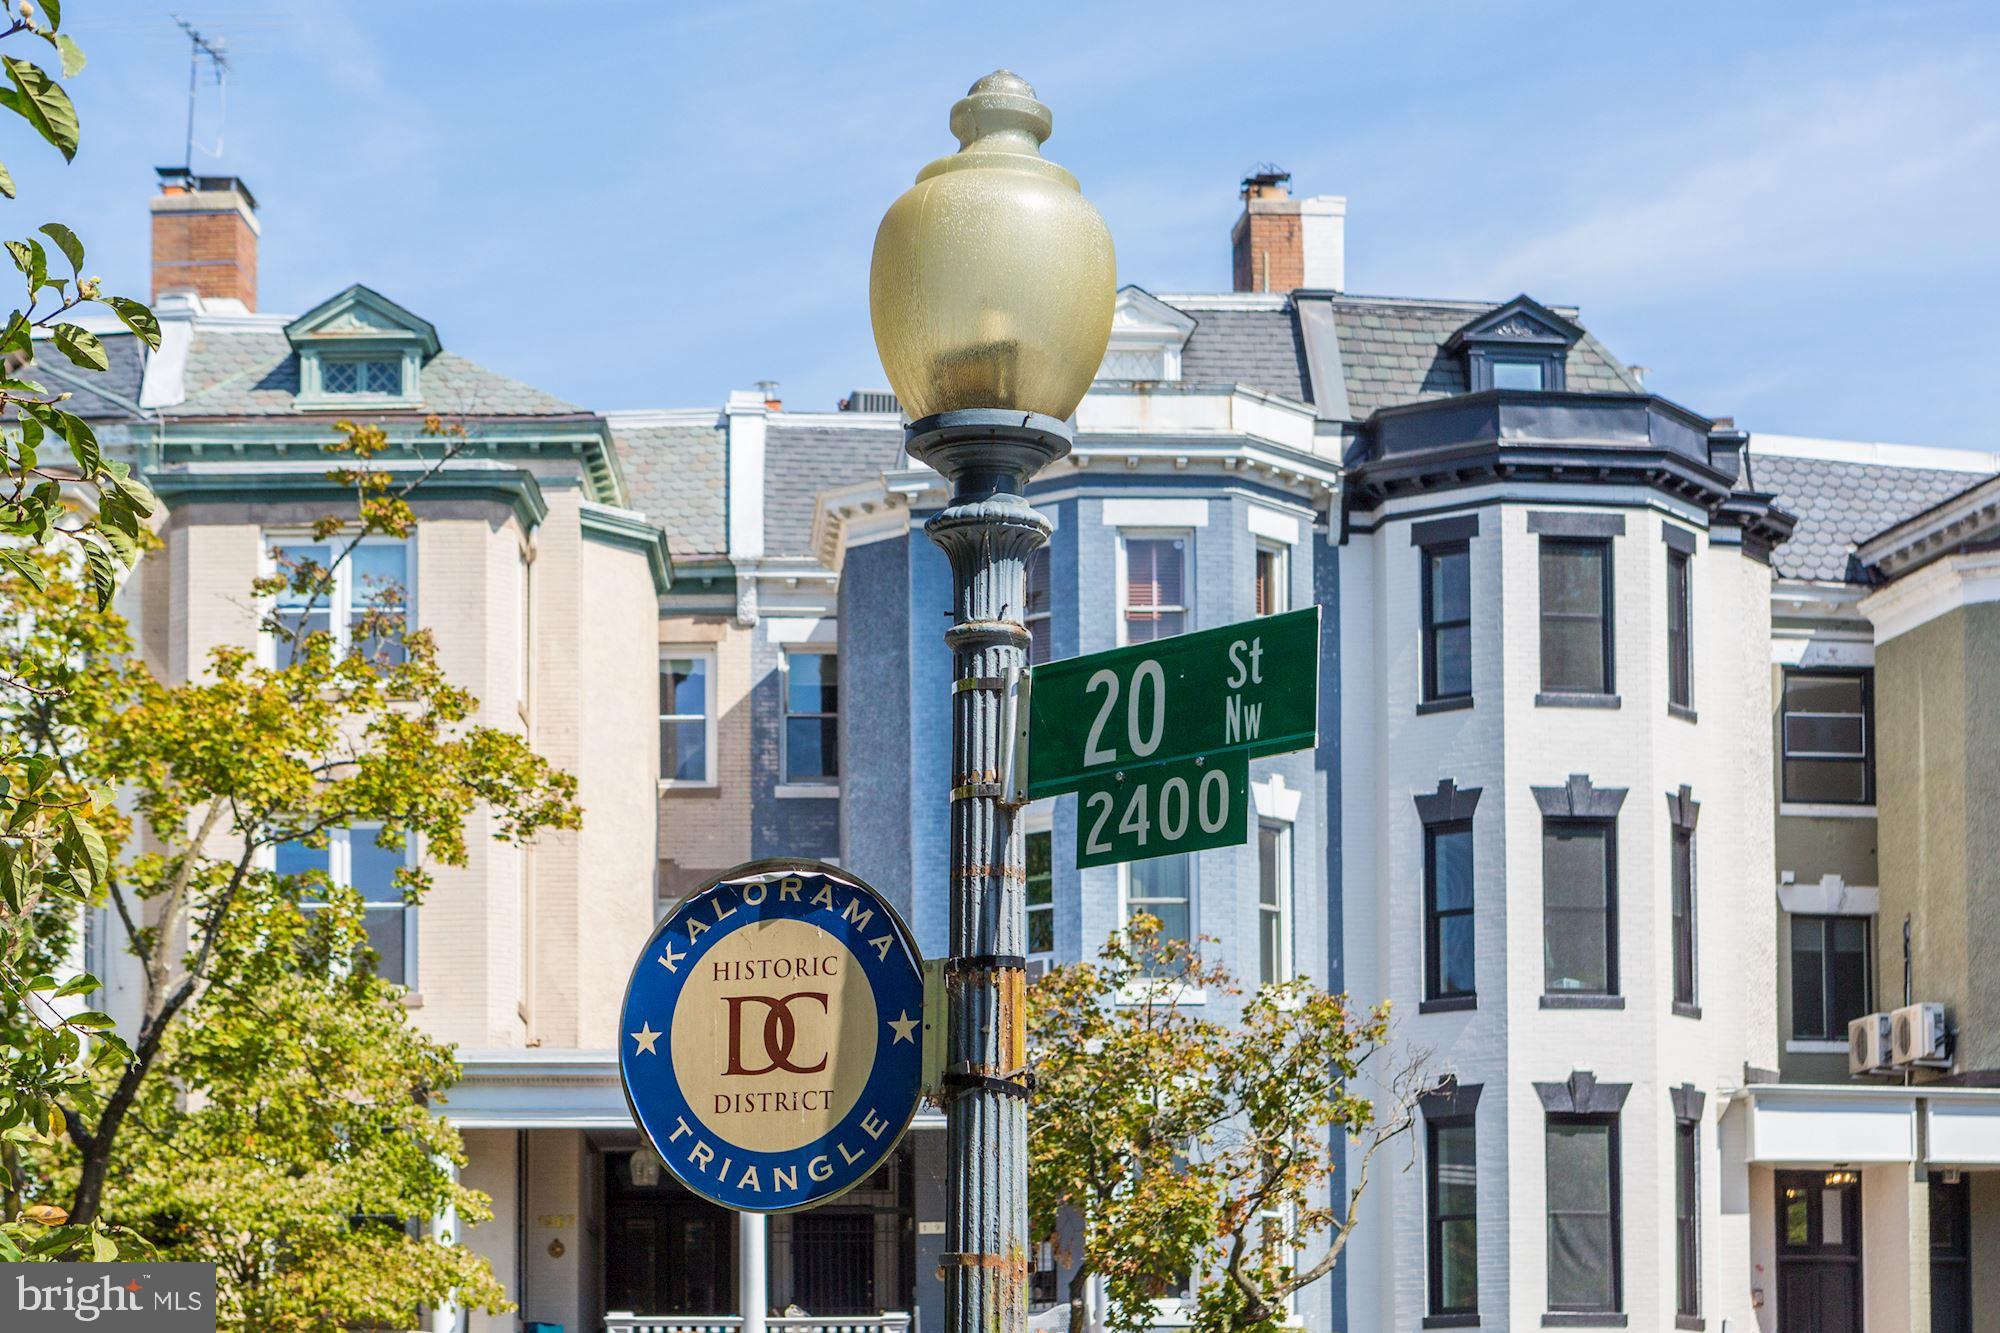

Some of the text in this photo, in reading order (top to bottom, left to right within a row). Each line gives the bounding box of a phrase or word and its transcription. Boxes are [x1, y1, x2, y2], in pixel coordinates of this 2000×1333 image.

[1226, 636, 1264, 689] St
[1083, 659, 1166, 767] 20
[1085, 769, 1230, 856] 2400
[657, 877, 896, 974] KALORAMA
[712, 955, 838, 981] HISTORIC
[720, 991, 829, 1076] DC
[714, 1090, 835, 1114] DISTRICT
[667, 1107, 890, 1193] TRIANGLE
